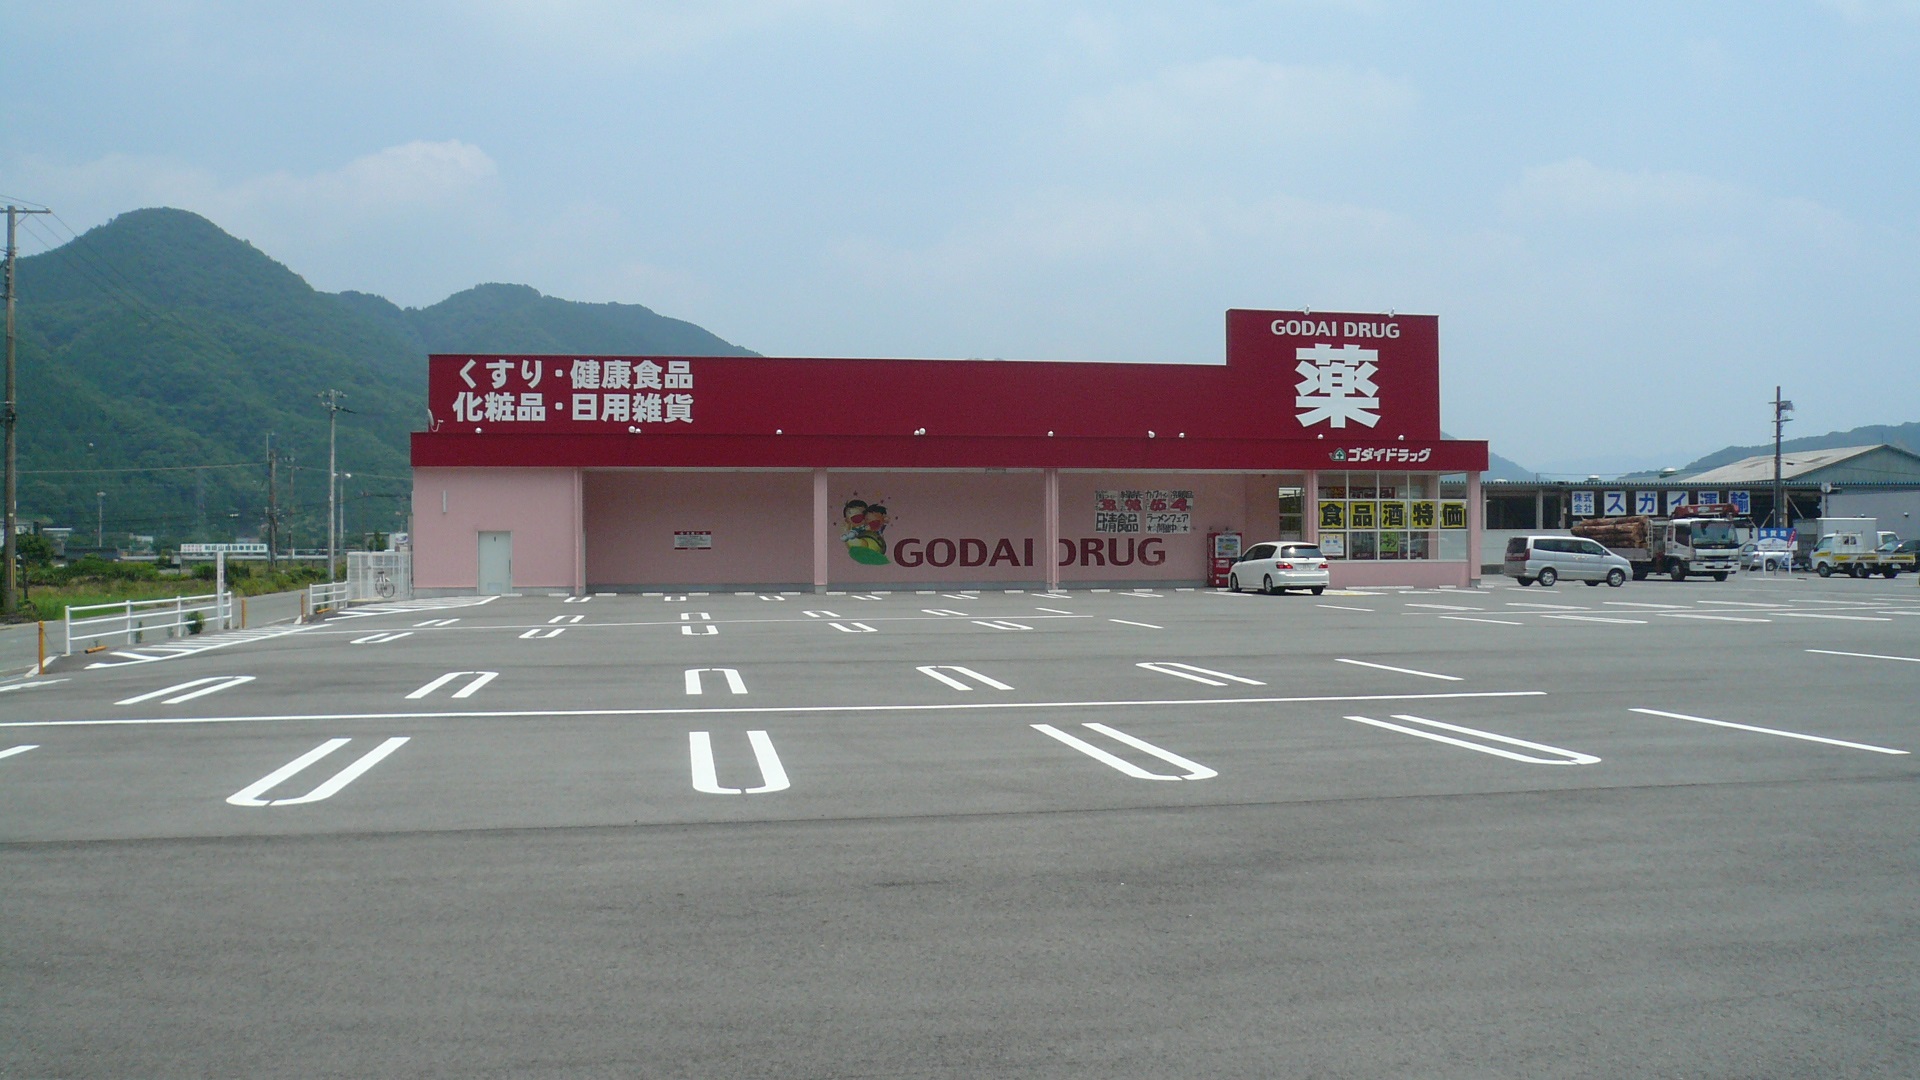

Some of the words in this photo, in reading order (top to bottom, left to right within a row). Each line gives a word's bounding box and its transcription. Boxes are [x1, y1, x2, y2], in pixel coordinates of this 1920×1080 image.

[1271, 320, 1337, 337] GODAI
[1344, 322, 1400, 338] DRUG
[459, 359, 694, 389] くすり・健康食品
[1294, 343, 1381, 428] 薬
[452, 392, 694, 423] 化粧品・日用雑貨
[1348, 448, 1431, 462] ゴダイドラッグ
[1096, 512, 1139, 532] 日清食品
[1147, 513, 1189, 522] ラーメンフェア
[1321, 503, 1463, 526] 食品酒特価
[893, 538, 1034, 567] GODAI
[1058, 538, 1166, 567] DRUG
